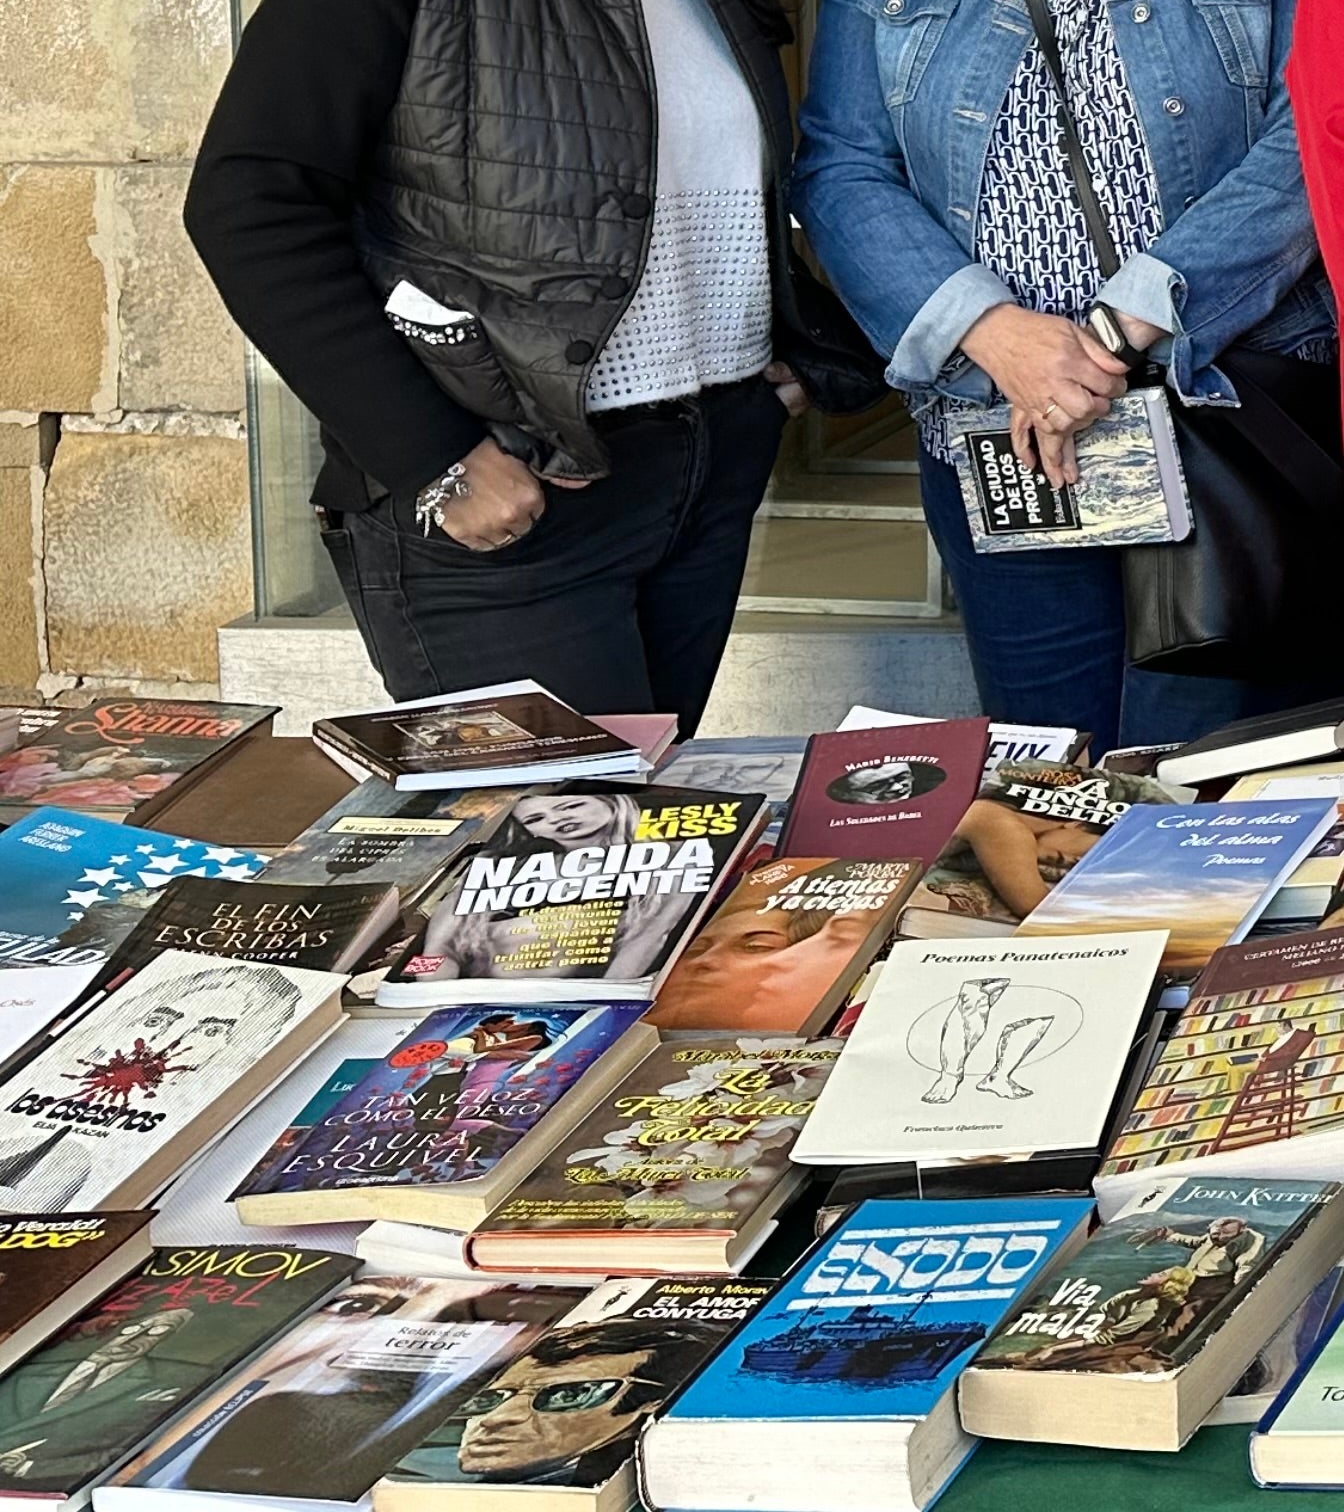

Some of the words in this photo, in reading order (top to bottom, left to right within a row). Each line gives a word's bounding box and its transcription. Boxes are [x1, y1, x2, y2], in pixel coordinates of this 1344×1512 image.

[979, 439, 1004, 501] CIUDAD
[999, 453, 1017, 486] LOS
[1006, 488, 1023, 510] DE
[994, 505, 1010, 525] LA
[65, 703, 243, 745] Shanna
[640, 802, 742, 823] LESLY
[1155, 815, 1208, 830] Con
[1216, 812, 1244, 826] las
[1250, 811, 1301, 826] alas
[634, 818, 739, 840] KISS
[1180, 831, 1215, 848] del
[1220, 832, 1284, 846] alma
[466, 839, 715, 887] NACIDA
[1202, 853, 1266, 867] Poemas
[457, 867, 714, 916] INOCENTE
[778, 876, 803, 893] A
[810, 875, 900, 895] tientas
[211, 903, 245, 919] EL
[259, 902, 323, 920] FIN
[757, 895, 776, 912] y
[782, 896, 798, 909] a
[803, 892, 889, 912] ciegas
[209, 918, 248, 933] DE
[255, 919, 301, 933] LOS
[155, 926, 334, 947] ESCRIBAS
[920, 950, 998, 965] Poemas
[364, 1093, 427, 1109] TAN
[438, 1088, 534, 1107] VELOZ
[6, 1088, 47, 1114] los
[45, 1097, 167, 1133] asesinos
[323, 1107, 415, 1127] COMO
[422, 1105, 450, 1121] EL
[457, 1102, 542, 1120] DESEO
[331, 1131, 468, 1152] LAURA
[282, 1146, 483, 1175] ESQUIVEL
[1172, 1185, 1242, 1203] JOHN
[1049, 1278, 1102, 1306] Via
[1006, 1308, 1106, 1338] mala
[384, 1337, 462, 1352] terror
